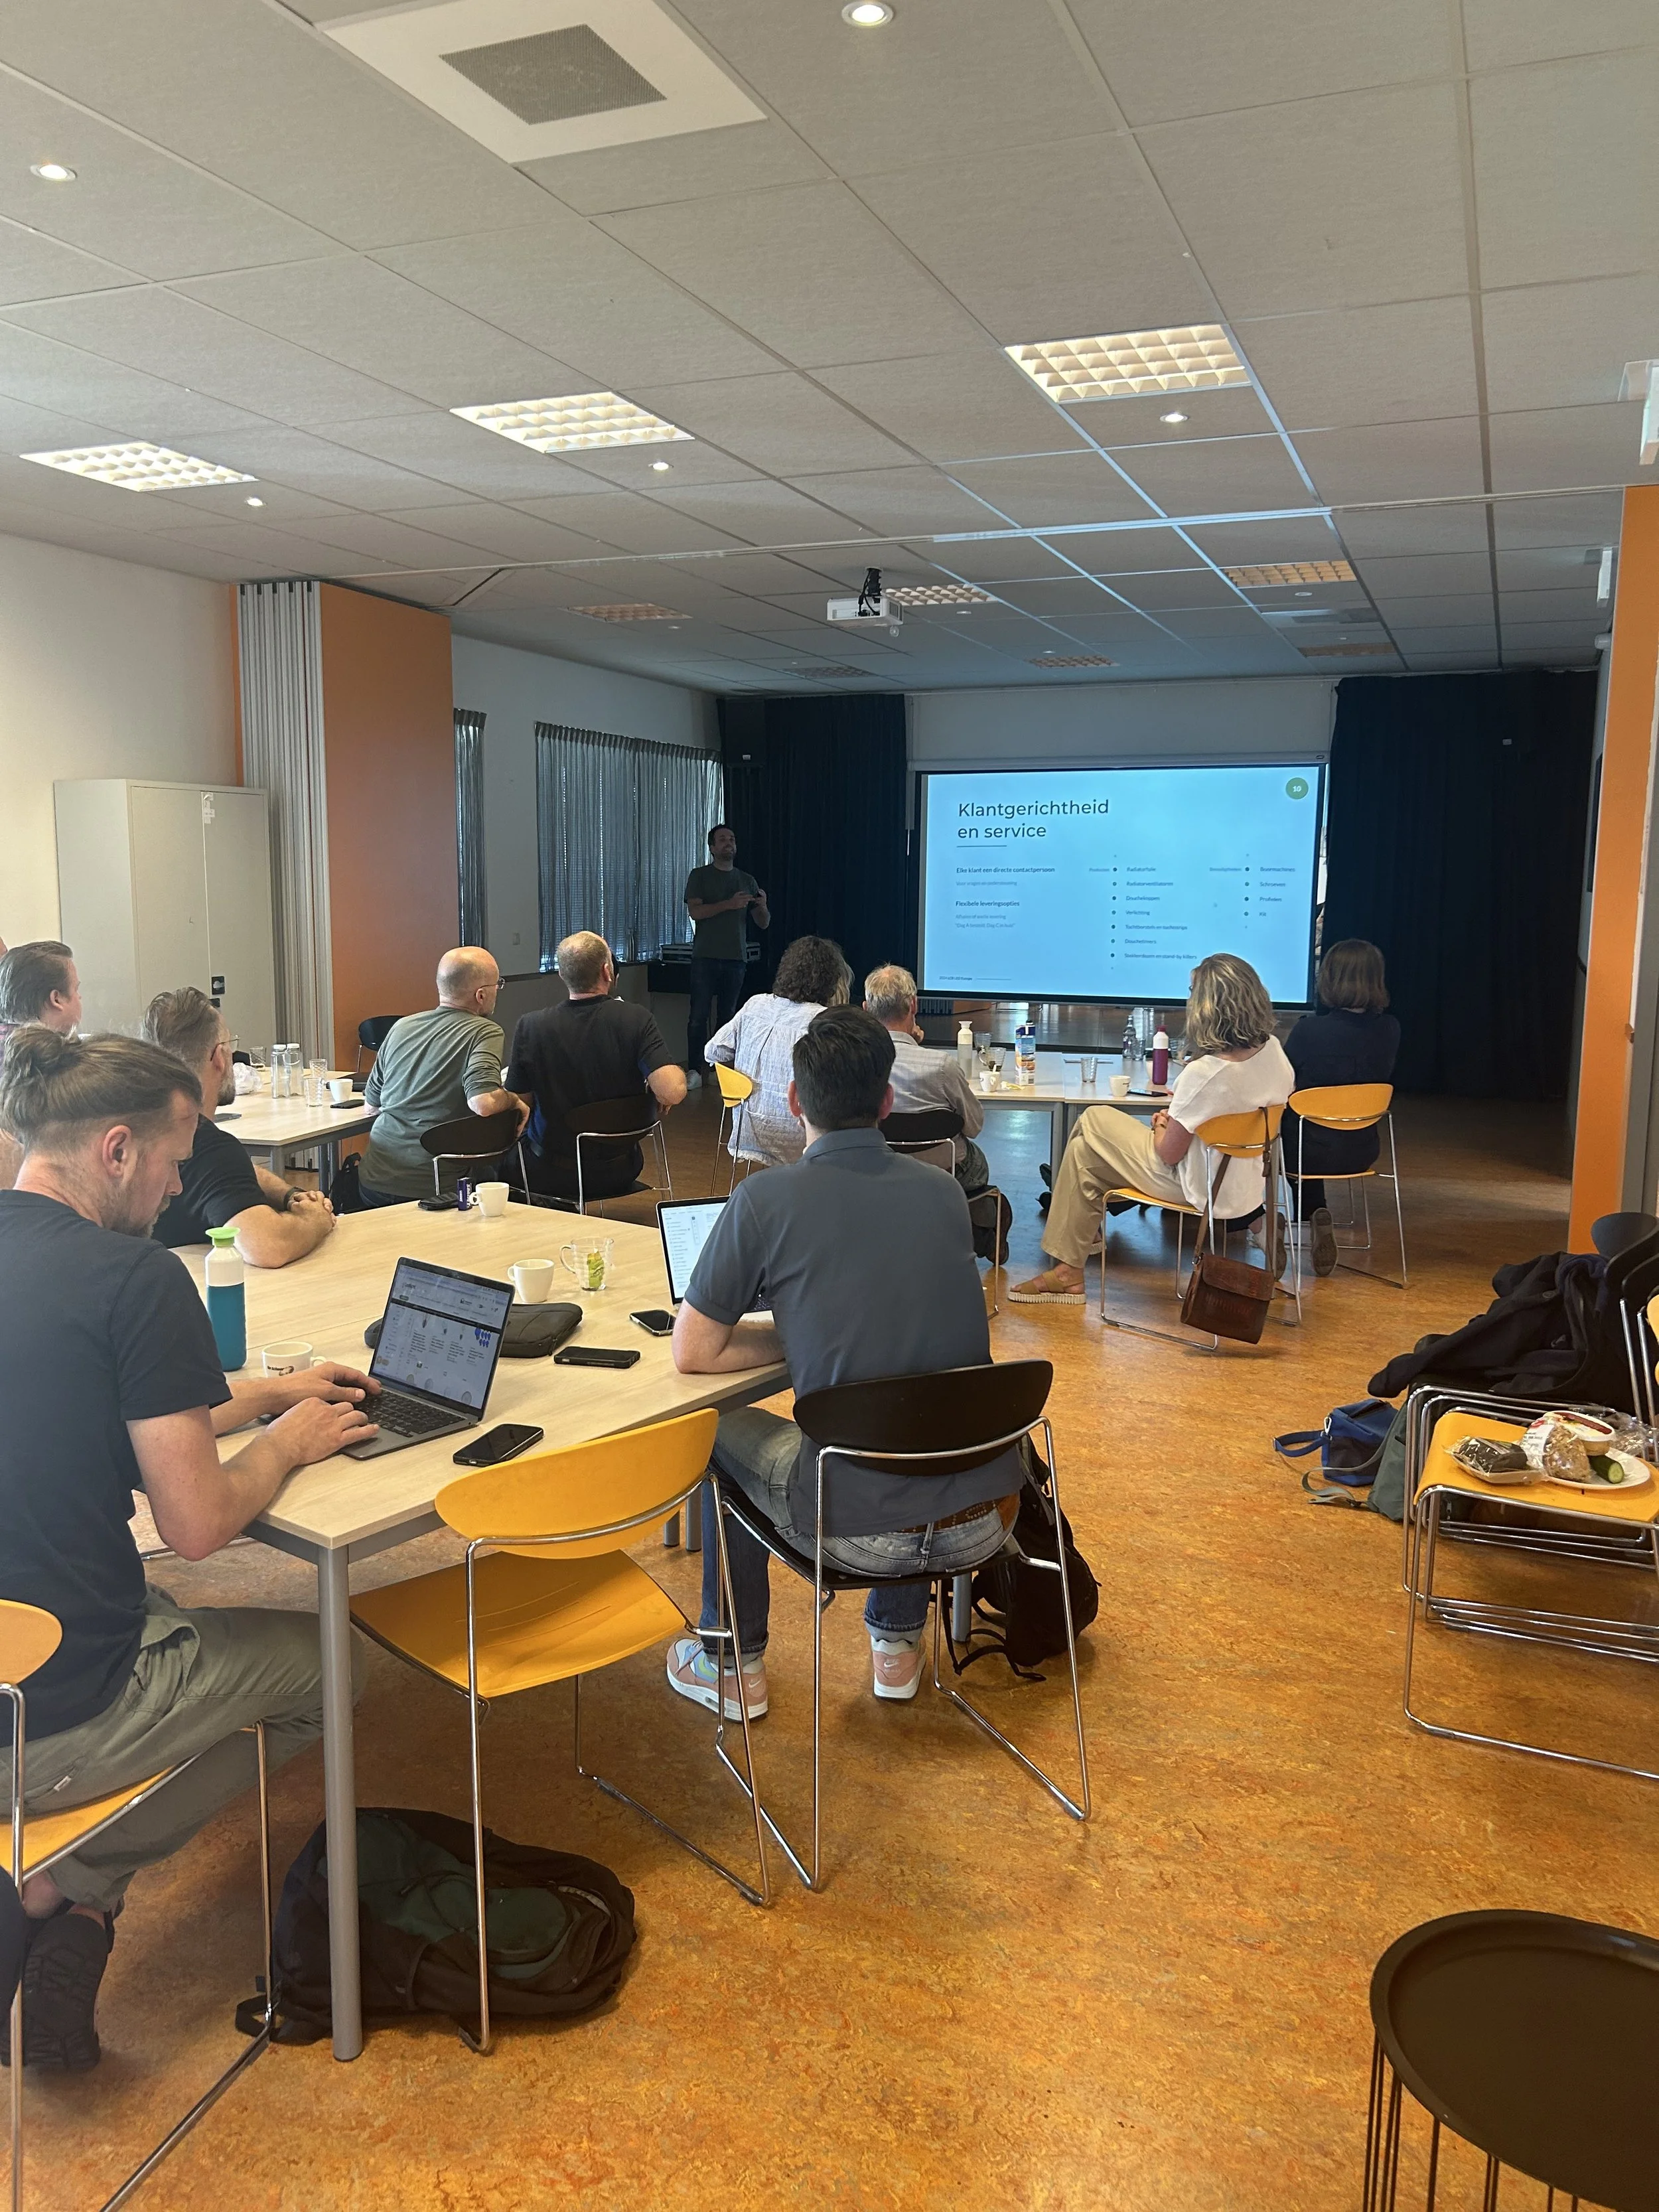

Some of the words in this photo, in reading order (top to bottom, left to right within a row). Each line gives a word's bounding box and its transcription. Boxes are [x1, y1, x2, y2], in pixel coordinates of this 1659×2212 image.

[958, 799, 1109, 820] Klantgerichtheid
[958, 828, 979, 839] en
[984, 823, 1046, 839] service
